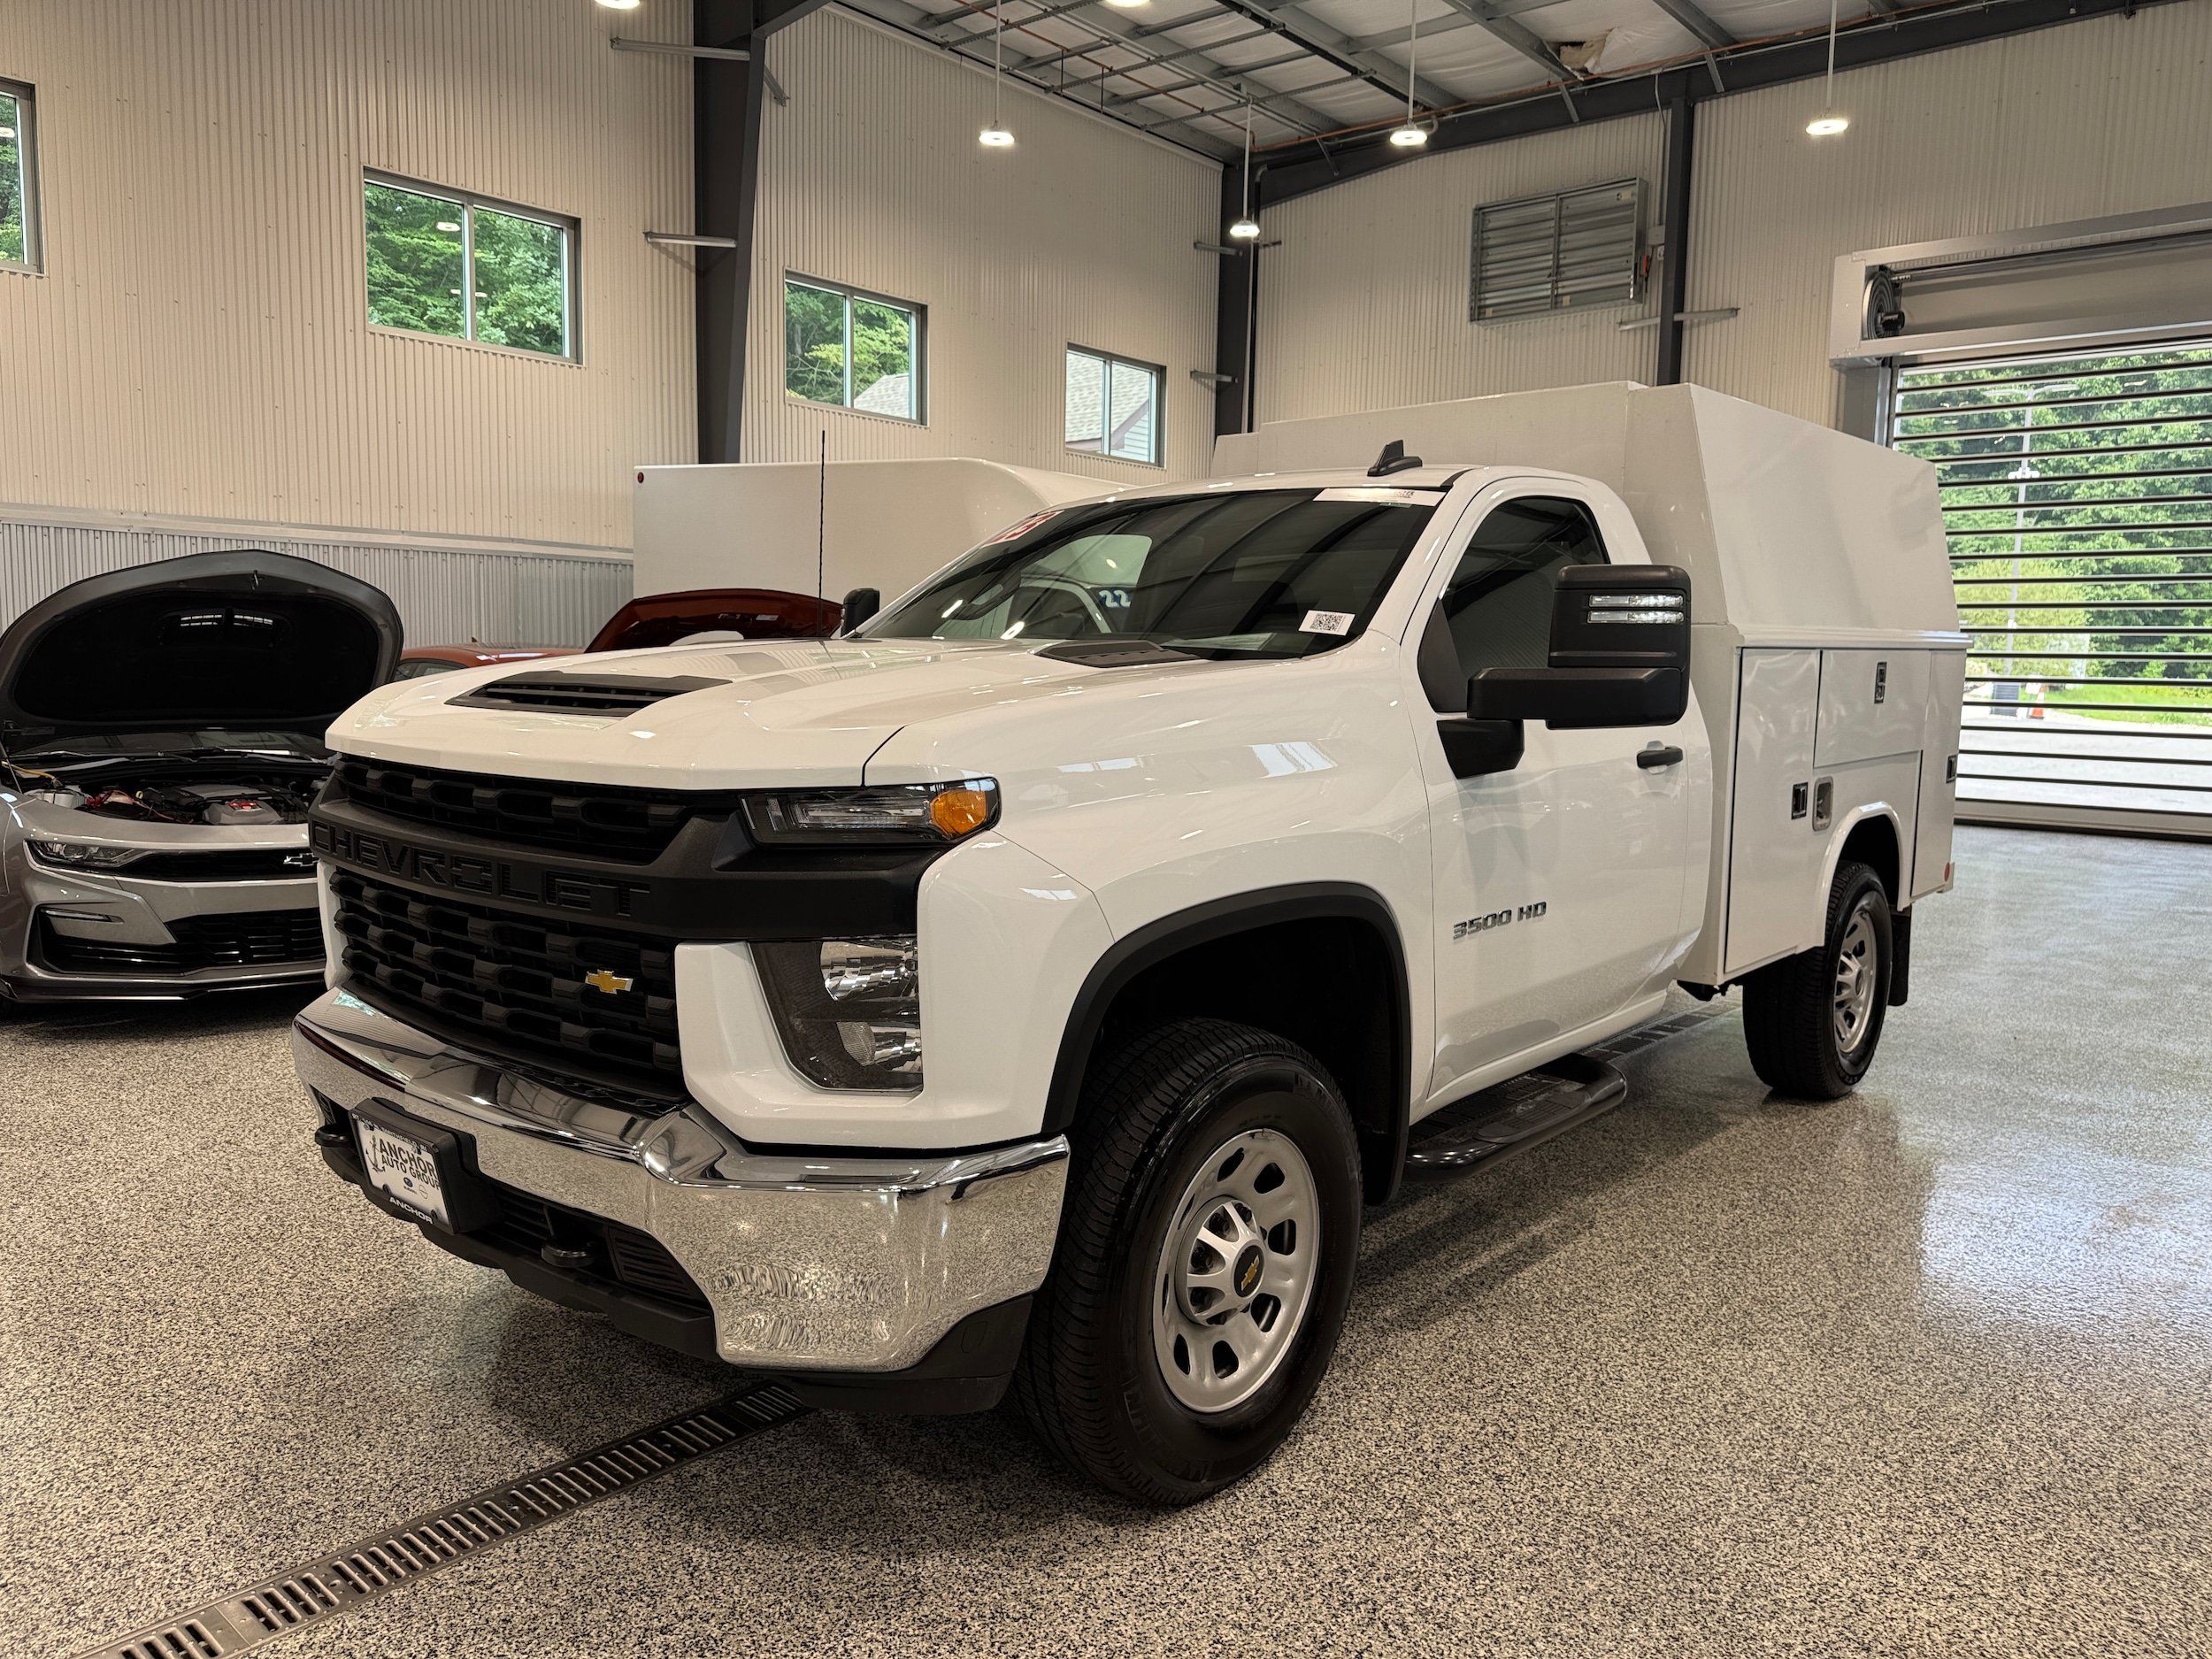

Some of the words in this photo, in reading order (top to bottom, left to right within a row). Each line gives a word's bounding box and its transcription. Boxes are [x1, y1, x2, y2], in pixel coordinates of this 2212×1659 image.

[1098, 589, 1132, 608] 22
[312, 818, 651, 917] CHEVROLET
[1453, 909, 1512, 940] 3500
[1517, 901, 1547, 922] HD
[379, 1138, 438, 1179] ANCHOR
[381, 1154, 408, 1174] AUTO
[409, 1166, 442, 1190] GROUP
[389, 1196, 434, 1225] ANCHOR
